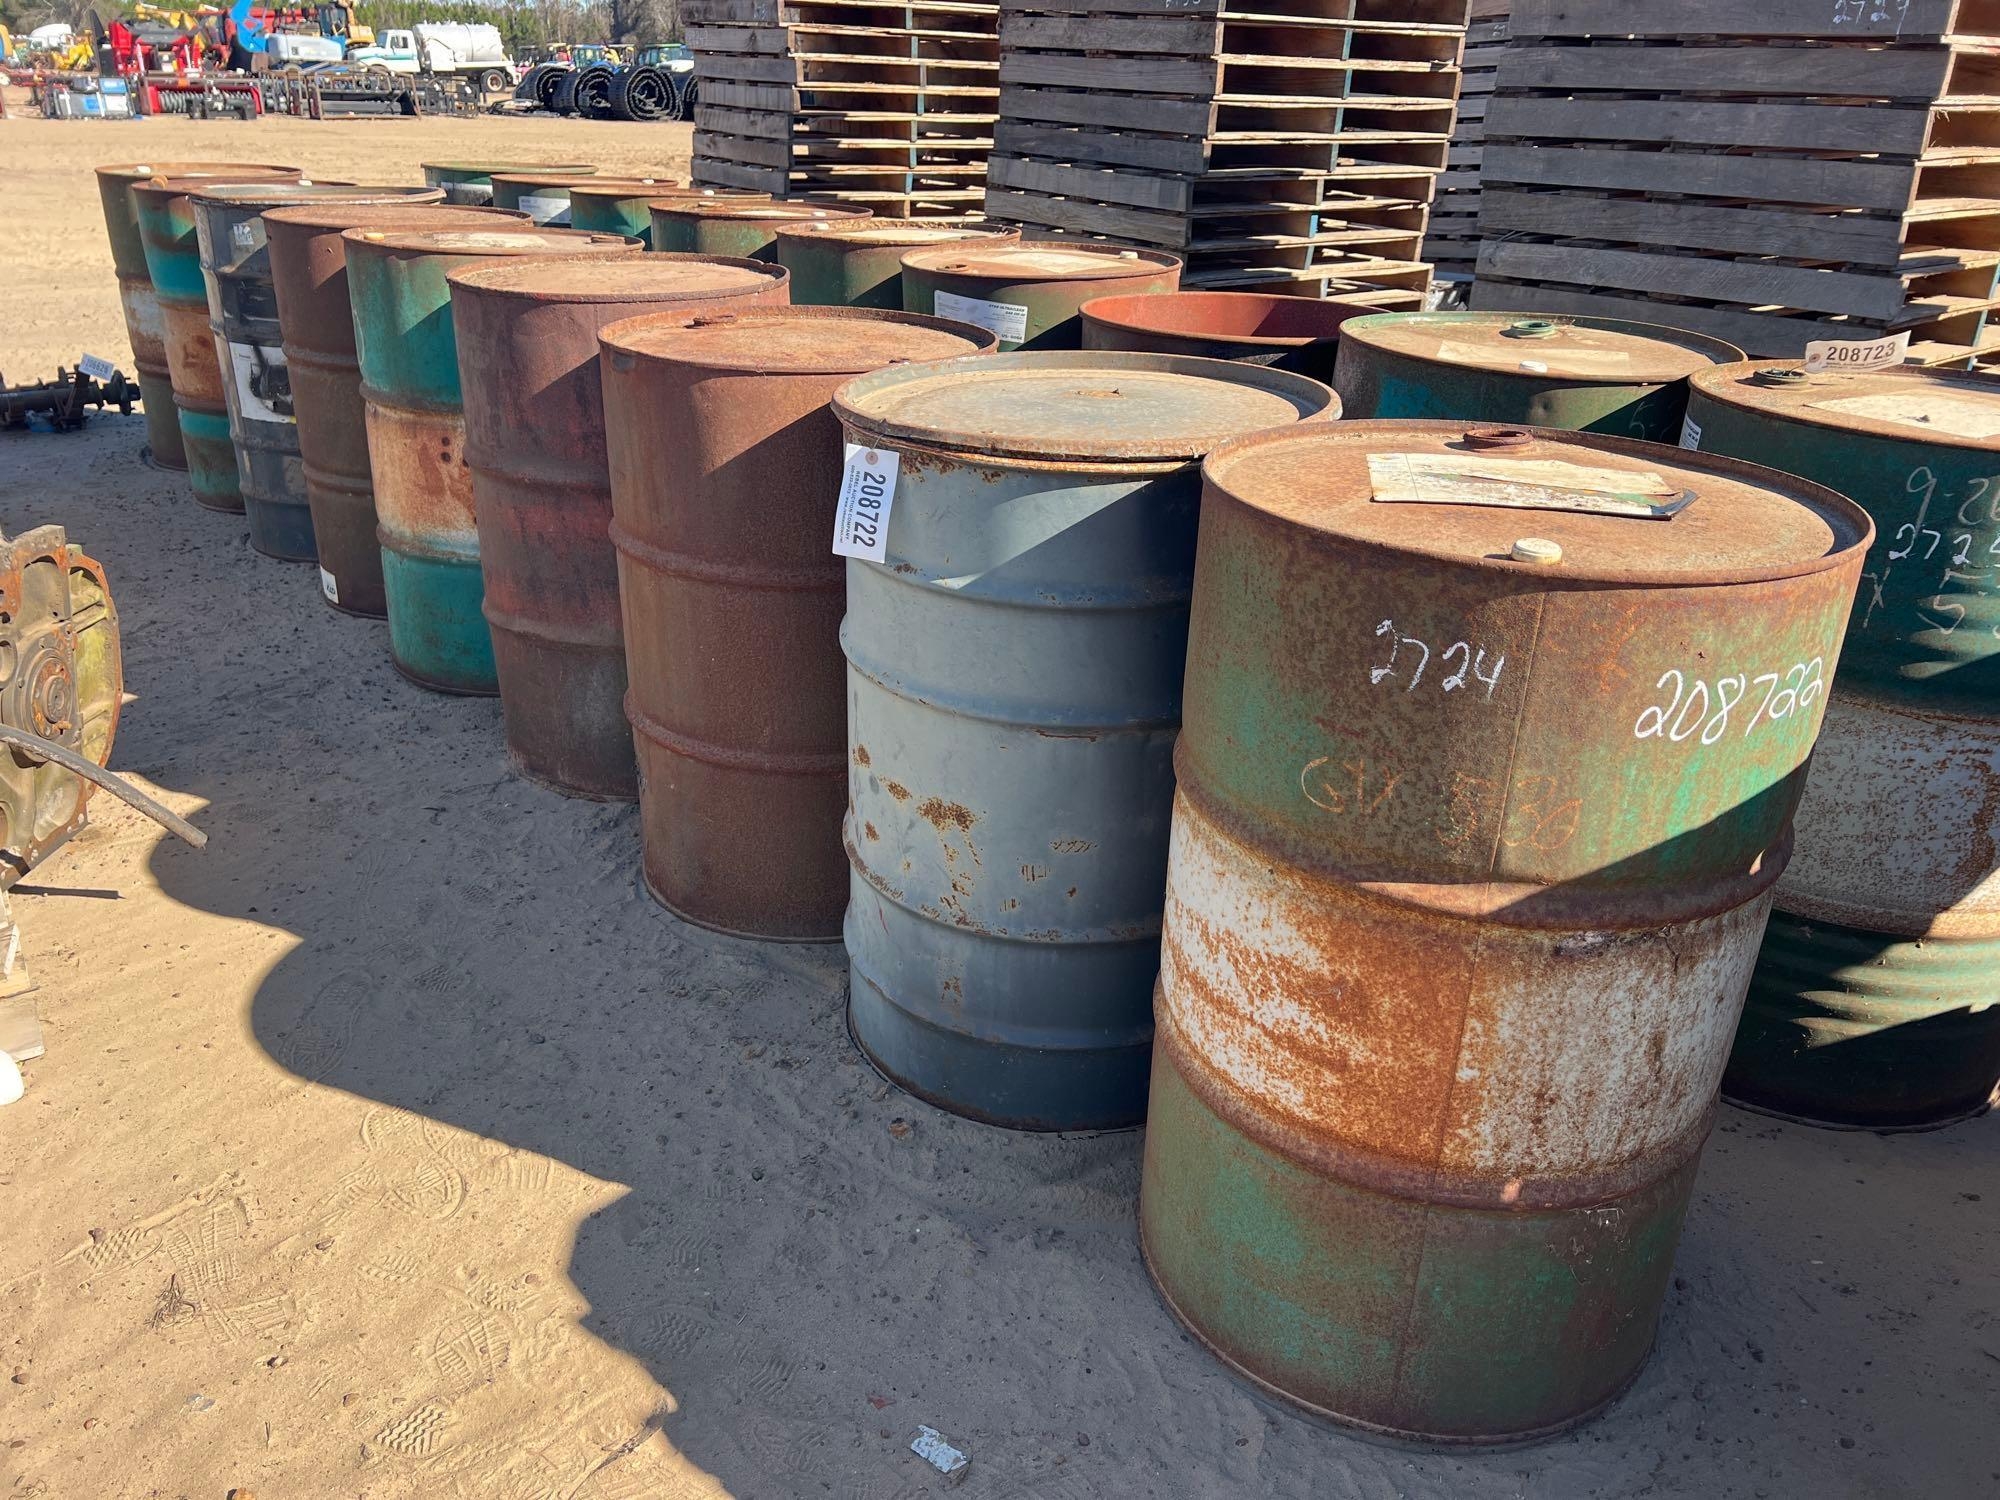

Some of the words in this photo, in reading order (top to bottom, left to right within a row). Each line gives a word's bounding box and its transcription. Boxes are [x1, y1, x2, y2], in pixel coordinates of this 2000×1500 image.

[1826, 342, 1897, 362] 208723
[845, 513, 853, 540] COMPANY
[849, 489, 857, 512] AUCTION
[852, 471, 887, 548] 208722
[1371, 619, 1506, 704] 2724
[1635, 657, 1823, 745] 208722
